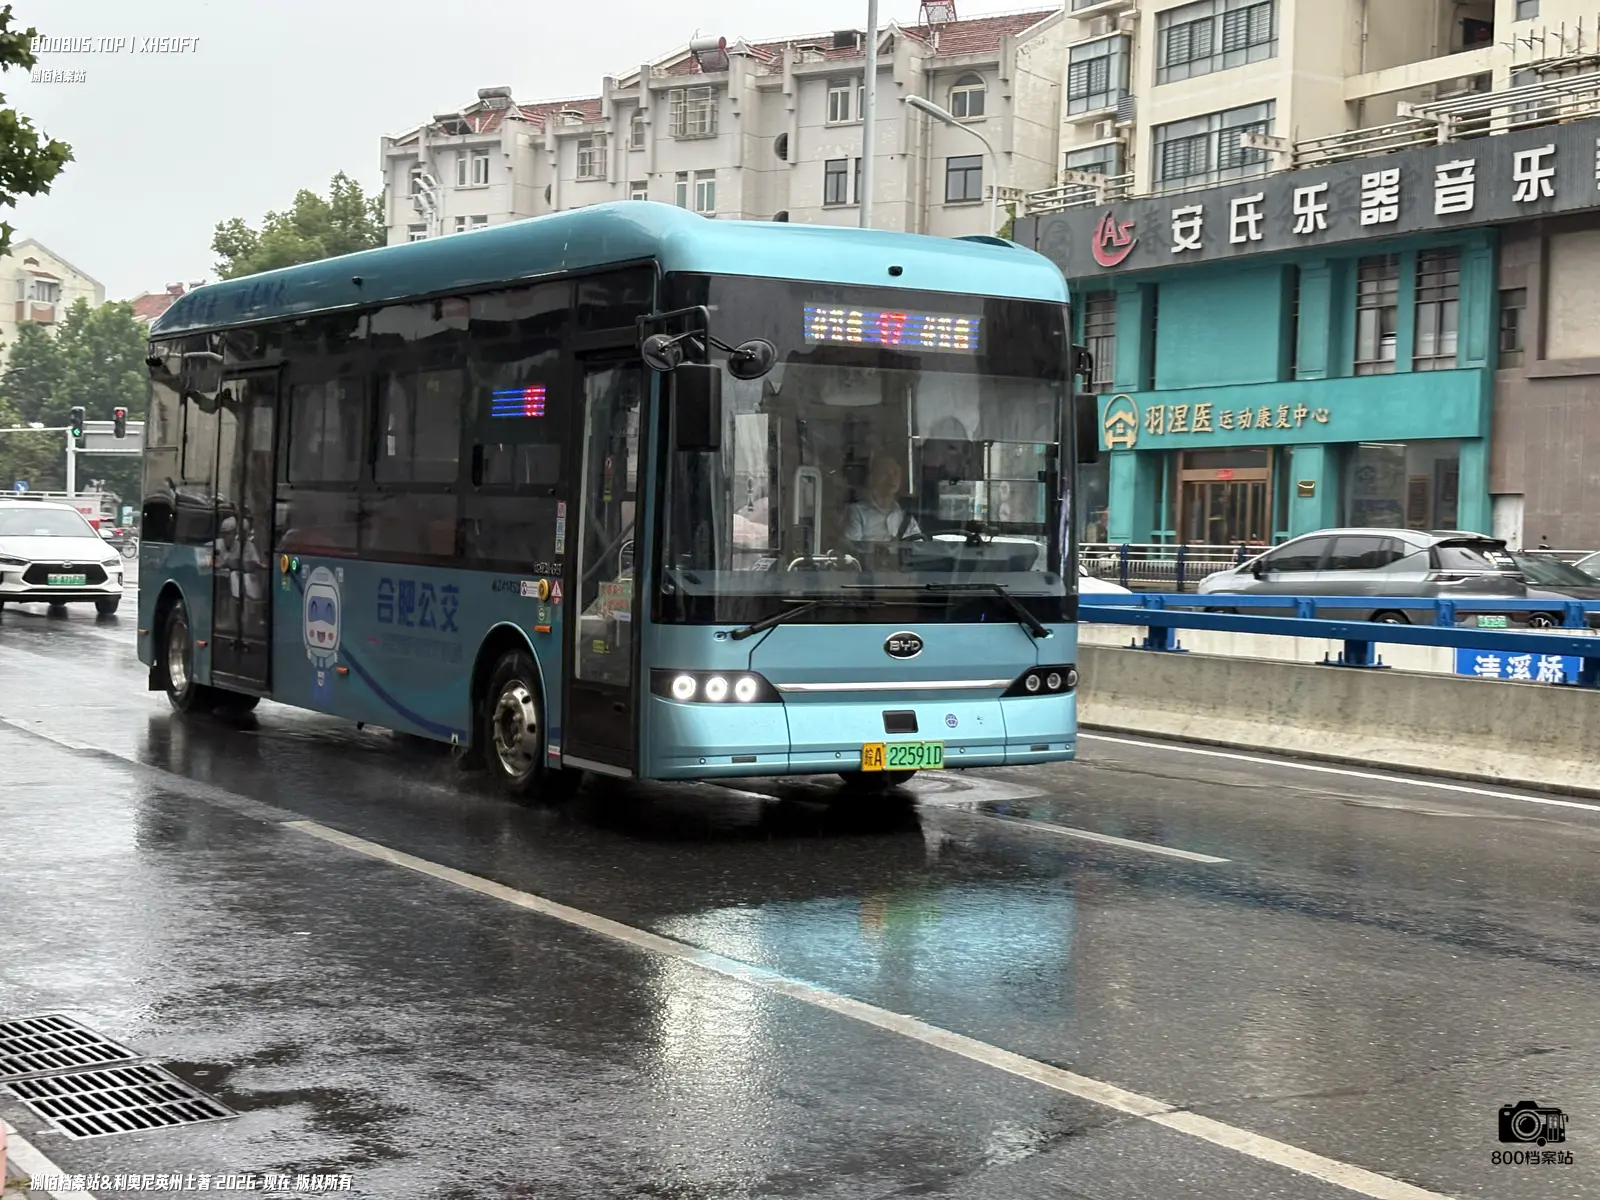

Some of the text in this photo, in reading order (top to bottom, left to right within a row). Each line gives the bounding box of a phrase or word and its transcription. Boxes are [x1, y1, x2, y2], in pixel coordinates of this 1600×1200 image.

[1171, 138, 1600, 254] 安氏乐器音乐
[377, 577, 459, 633] 合肥公交
[889, 640, 921, 651] BYD
[889, 746, 942, 767] 22591D
